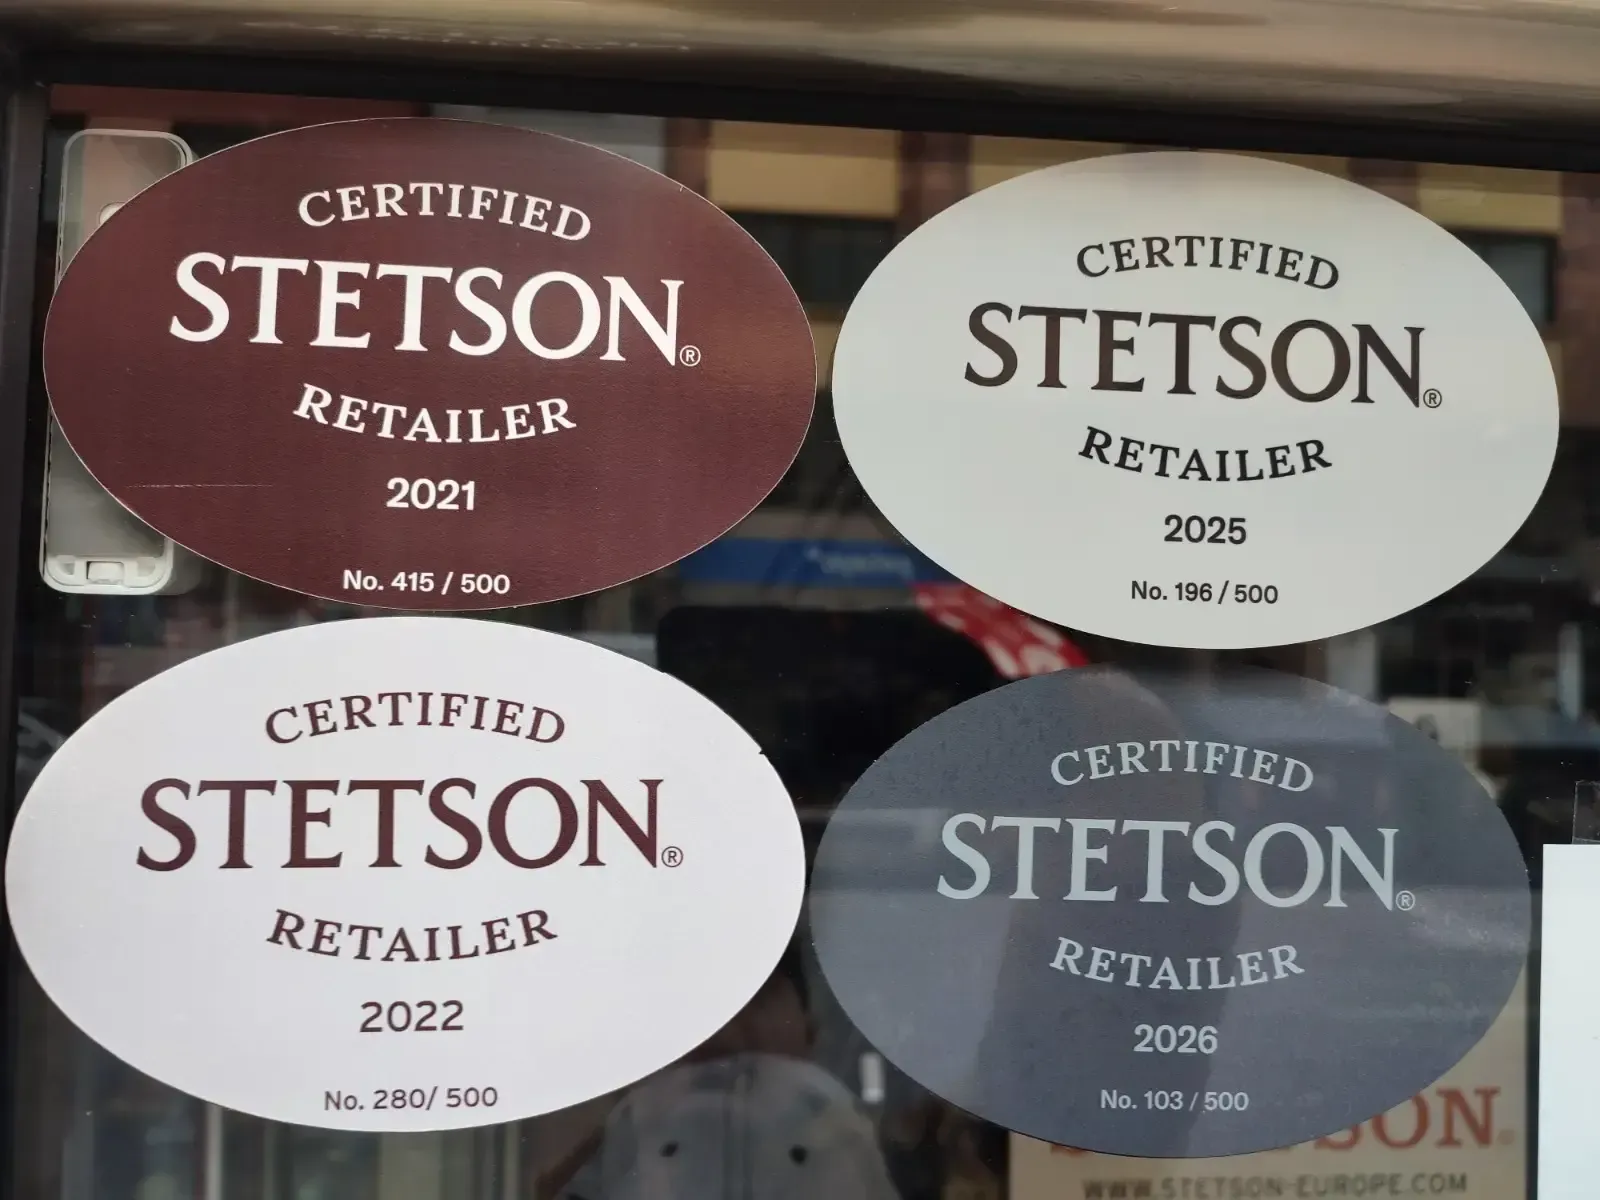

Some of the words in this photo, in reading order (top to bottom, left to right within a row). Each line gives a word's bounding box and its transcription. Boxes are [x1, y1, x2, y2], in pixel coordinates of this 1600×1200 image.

[298, 182, 591, 241] CERTIFIED
[1076, 235, 1340, 290] CERTIFIED
[292, 382, 577, 444] RETAILER
[1078, 425, 1333, 482] RETAILER
[386, 477, 475, 511] 2021
[1163, 514, 1247, 545] 2025
[343, 569, 385, 591] No.
[390, 571, 435, 593] 415
[440, 571, 454, 596] /
[460, 573, 511, 595] 500
[1131, 580, 1168, 601] No.
[1174, 581, 1213, 602] 196
[1217, 579, 1230, 605] /
[1234, 583, 1279, 605] 500
[265, 691, 565, 744] CERTIFIED
[1050, 739, 1314, 792] CERTIFIED
[266, 908, 558, 963] RETAILER
[1049, 936, 1306, 990] RETAILER
[359, 999, 464, 1033] 2022
[1133, 1023, 1219, 1055] 2026
[324, 1090, 365, 1111] No.
[446, 1086, 498, 1108] 500
[1100, 1089, 1138, 1109] No.
[1143, 1090, 1184, 1111] 103
[1188, 1091, 1199, 1112] /
[1203, 1091, 1250, 1112] 500
